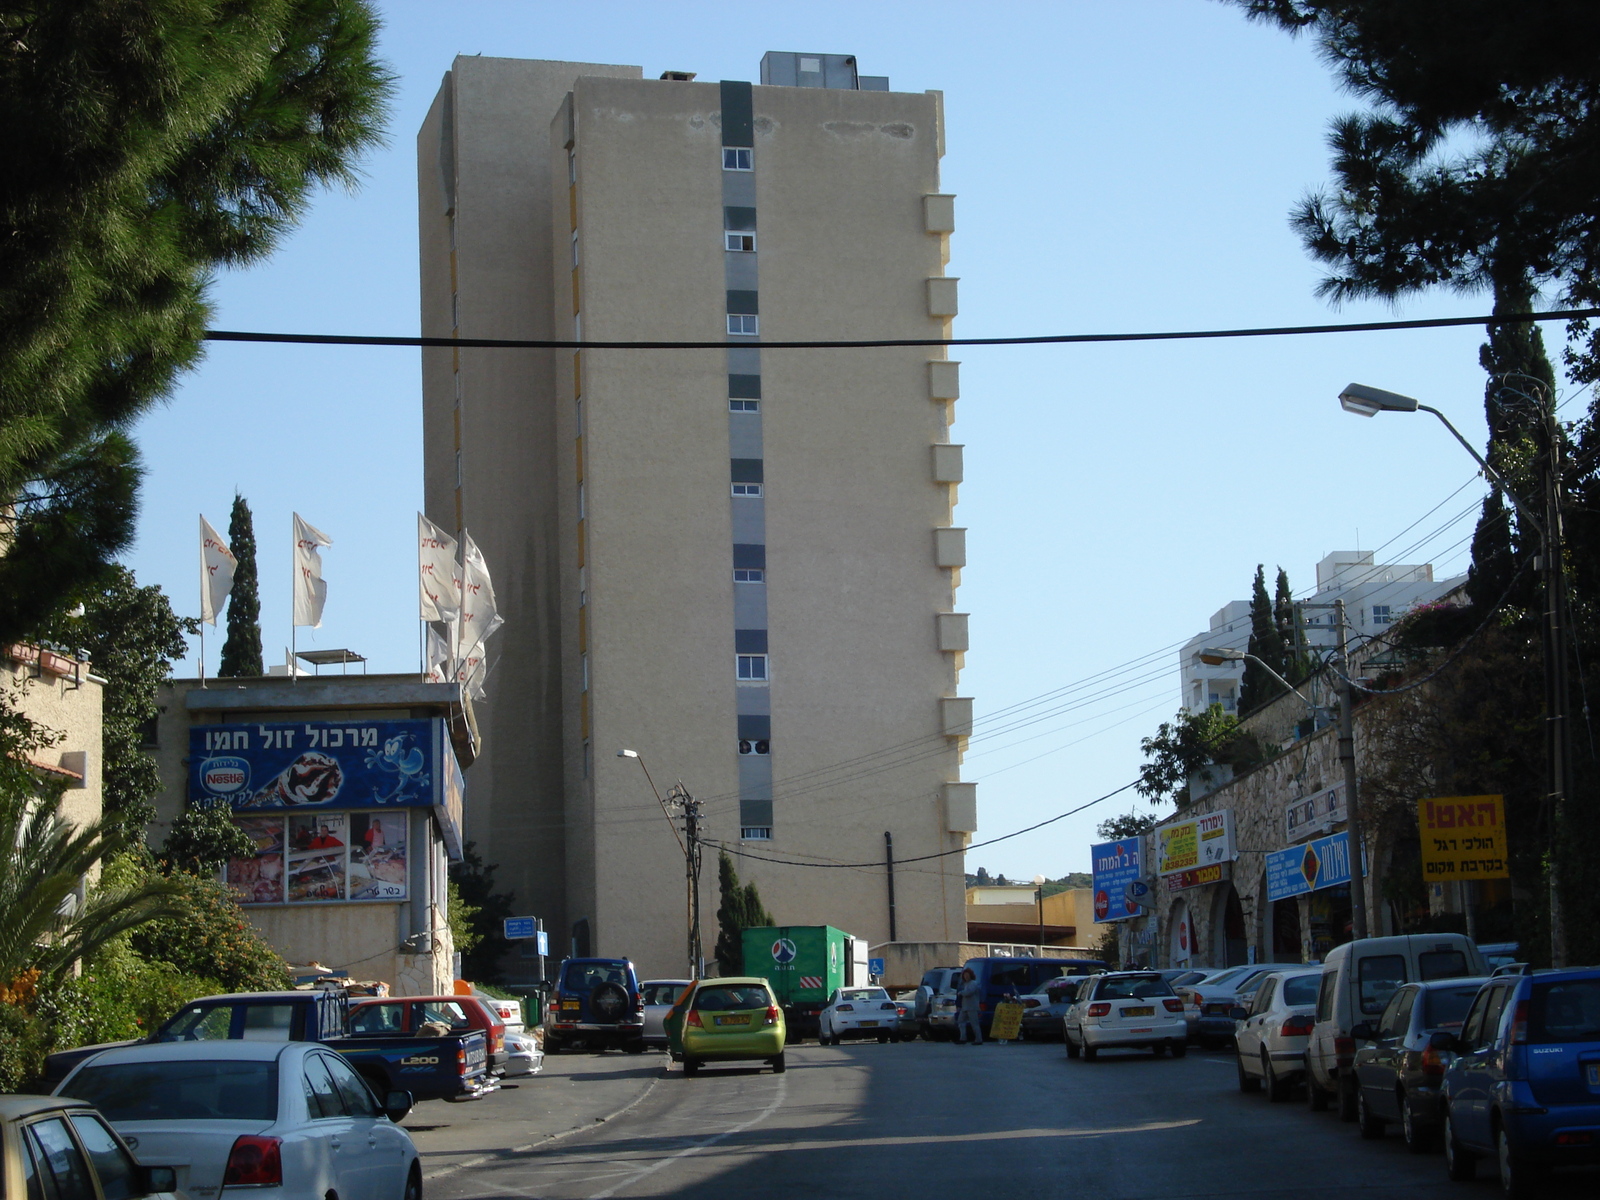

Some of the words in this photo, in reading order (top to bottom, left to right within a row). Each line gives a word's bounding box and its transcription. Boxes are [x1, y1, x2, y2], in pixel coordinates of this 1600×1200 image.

[259, 725, 295, 749] זול
[305, 724, 378, 748] מרכול
[212, 757, 239, 769] גלידות
[1426, 801, 1496, 828] האט!
[1199, 814, 1224, 832] נימרוד
[1433, 838, 1457, 851] רגל
[1462, 836, 1494, 850] הולכי
[1165, 856, 1197, 871] 8382351
[1426, 861, 1455, 875] מקום
[1460, 859, 1503, 873] בקרבת
[1195, 866, 1221, 883] טמבור
[400, 1056, 439, 1065] L200
